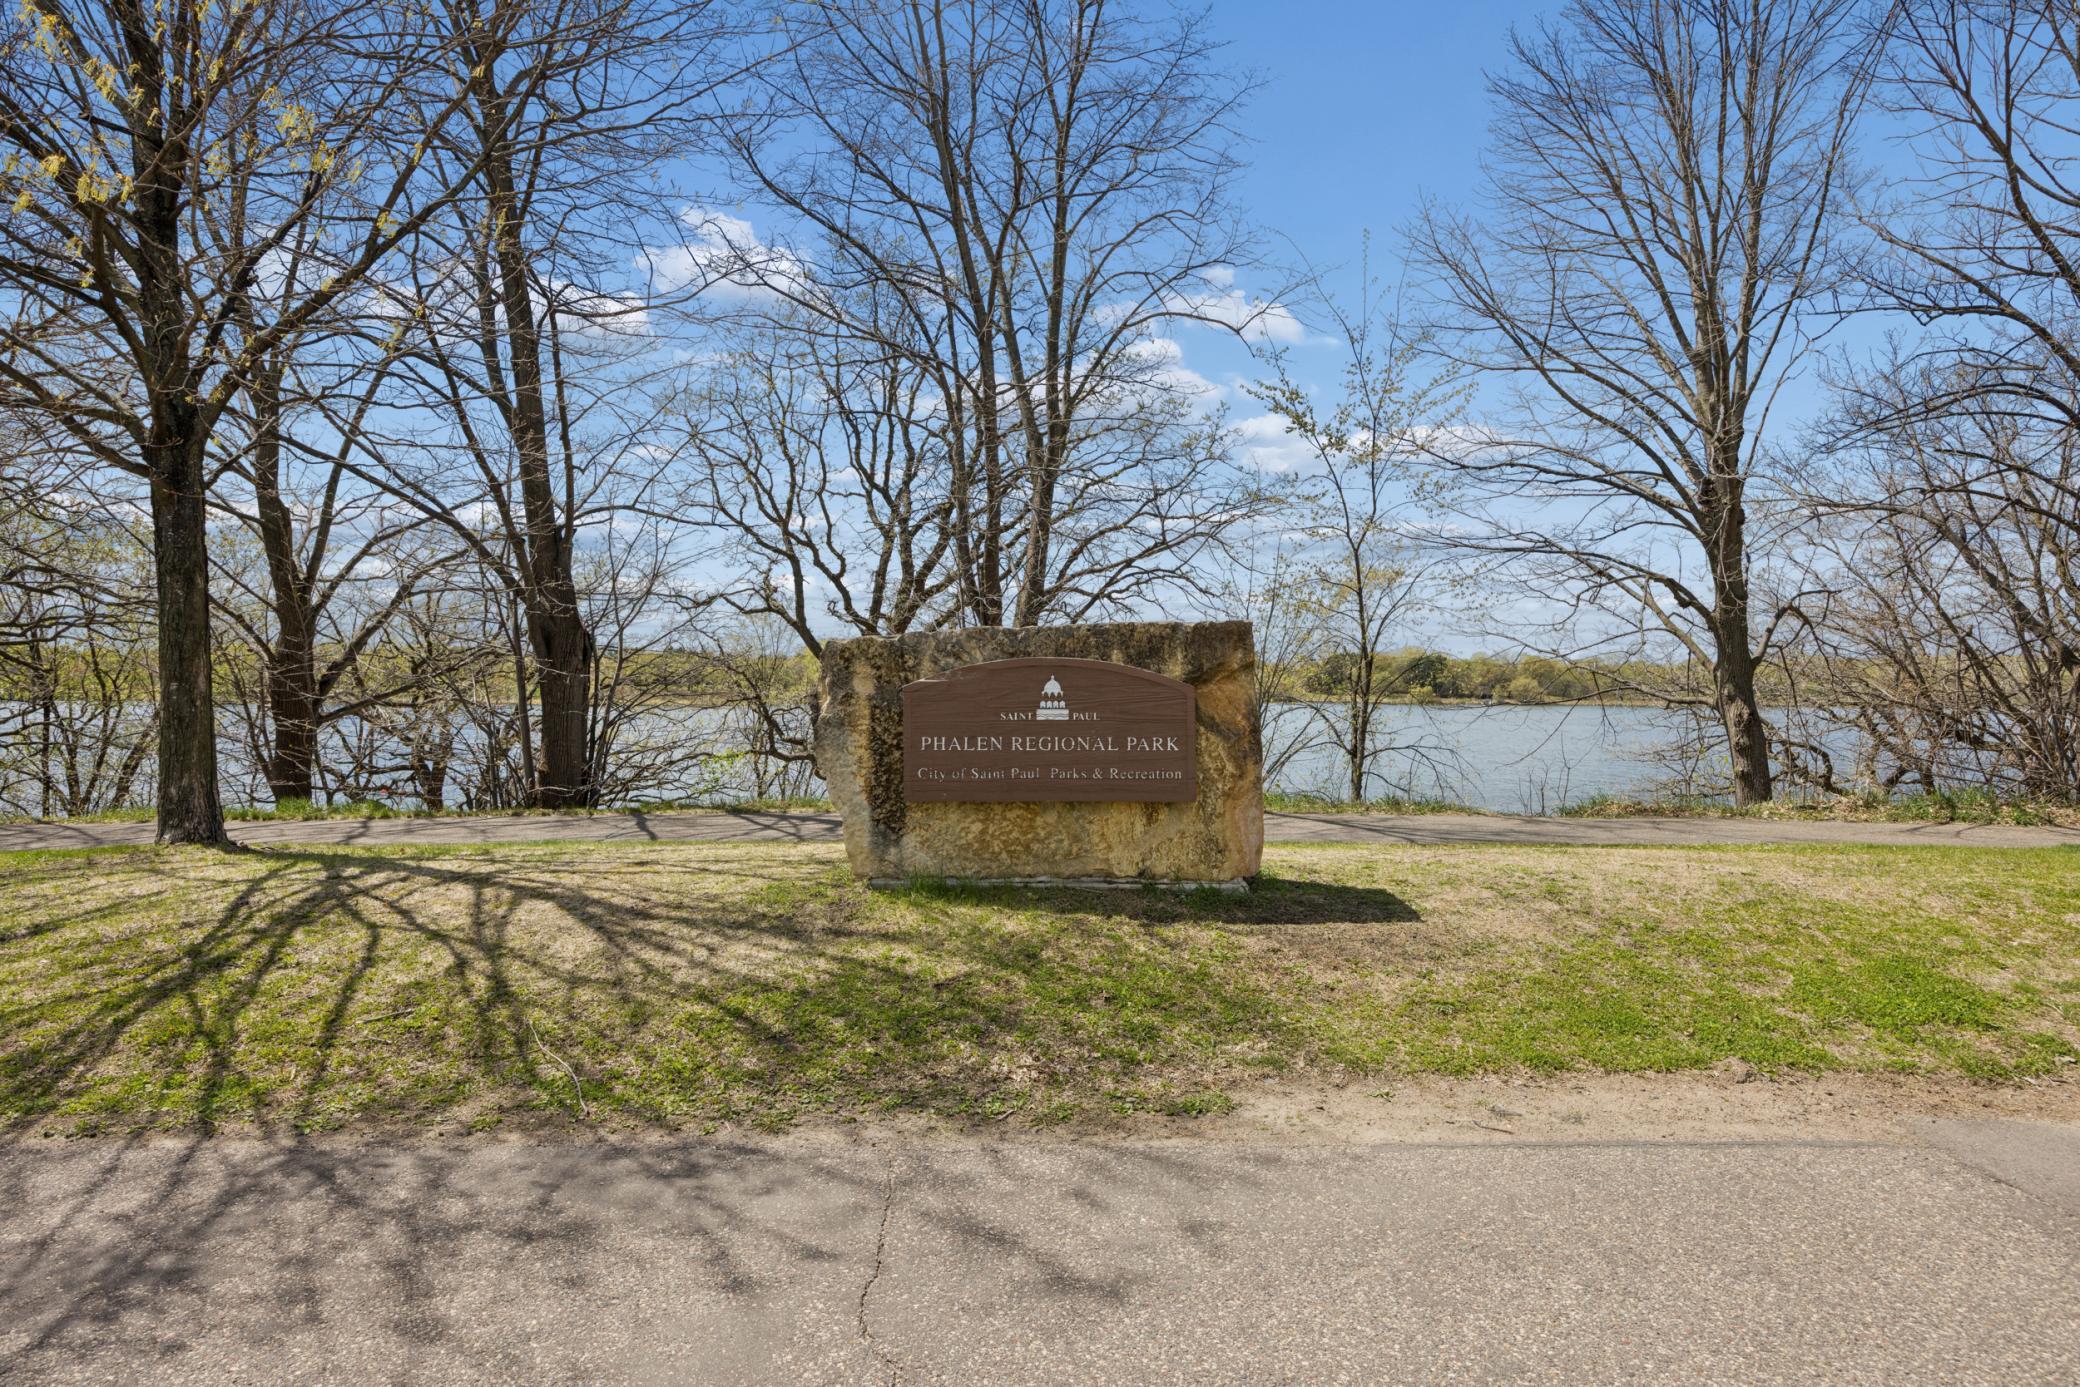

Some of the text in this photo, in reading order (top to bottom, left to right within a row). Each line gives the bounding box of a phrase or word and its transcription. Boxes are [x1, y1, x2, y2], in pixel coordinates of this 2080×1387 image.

[1000, 712, 1099, 721] SAINT PAUL
[921, 736, 1179, 751] PHALEN REGIONAL PARK
[917, 767, 1182, 782] City of Saint Paul Parks & Recreation
